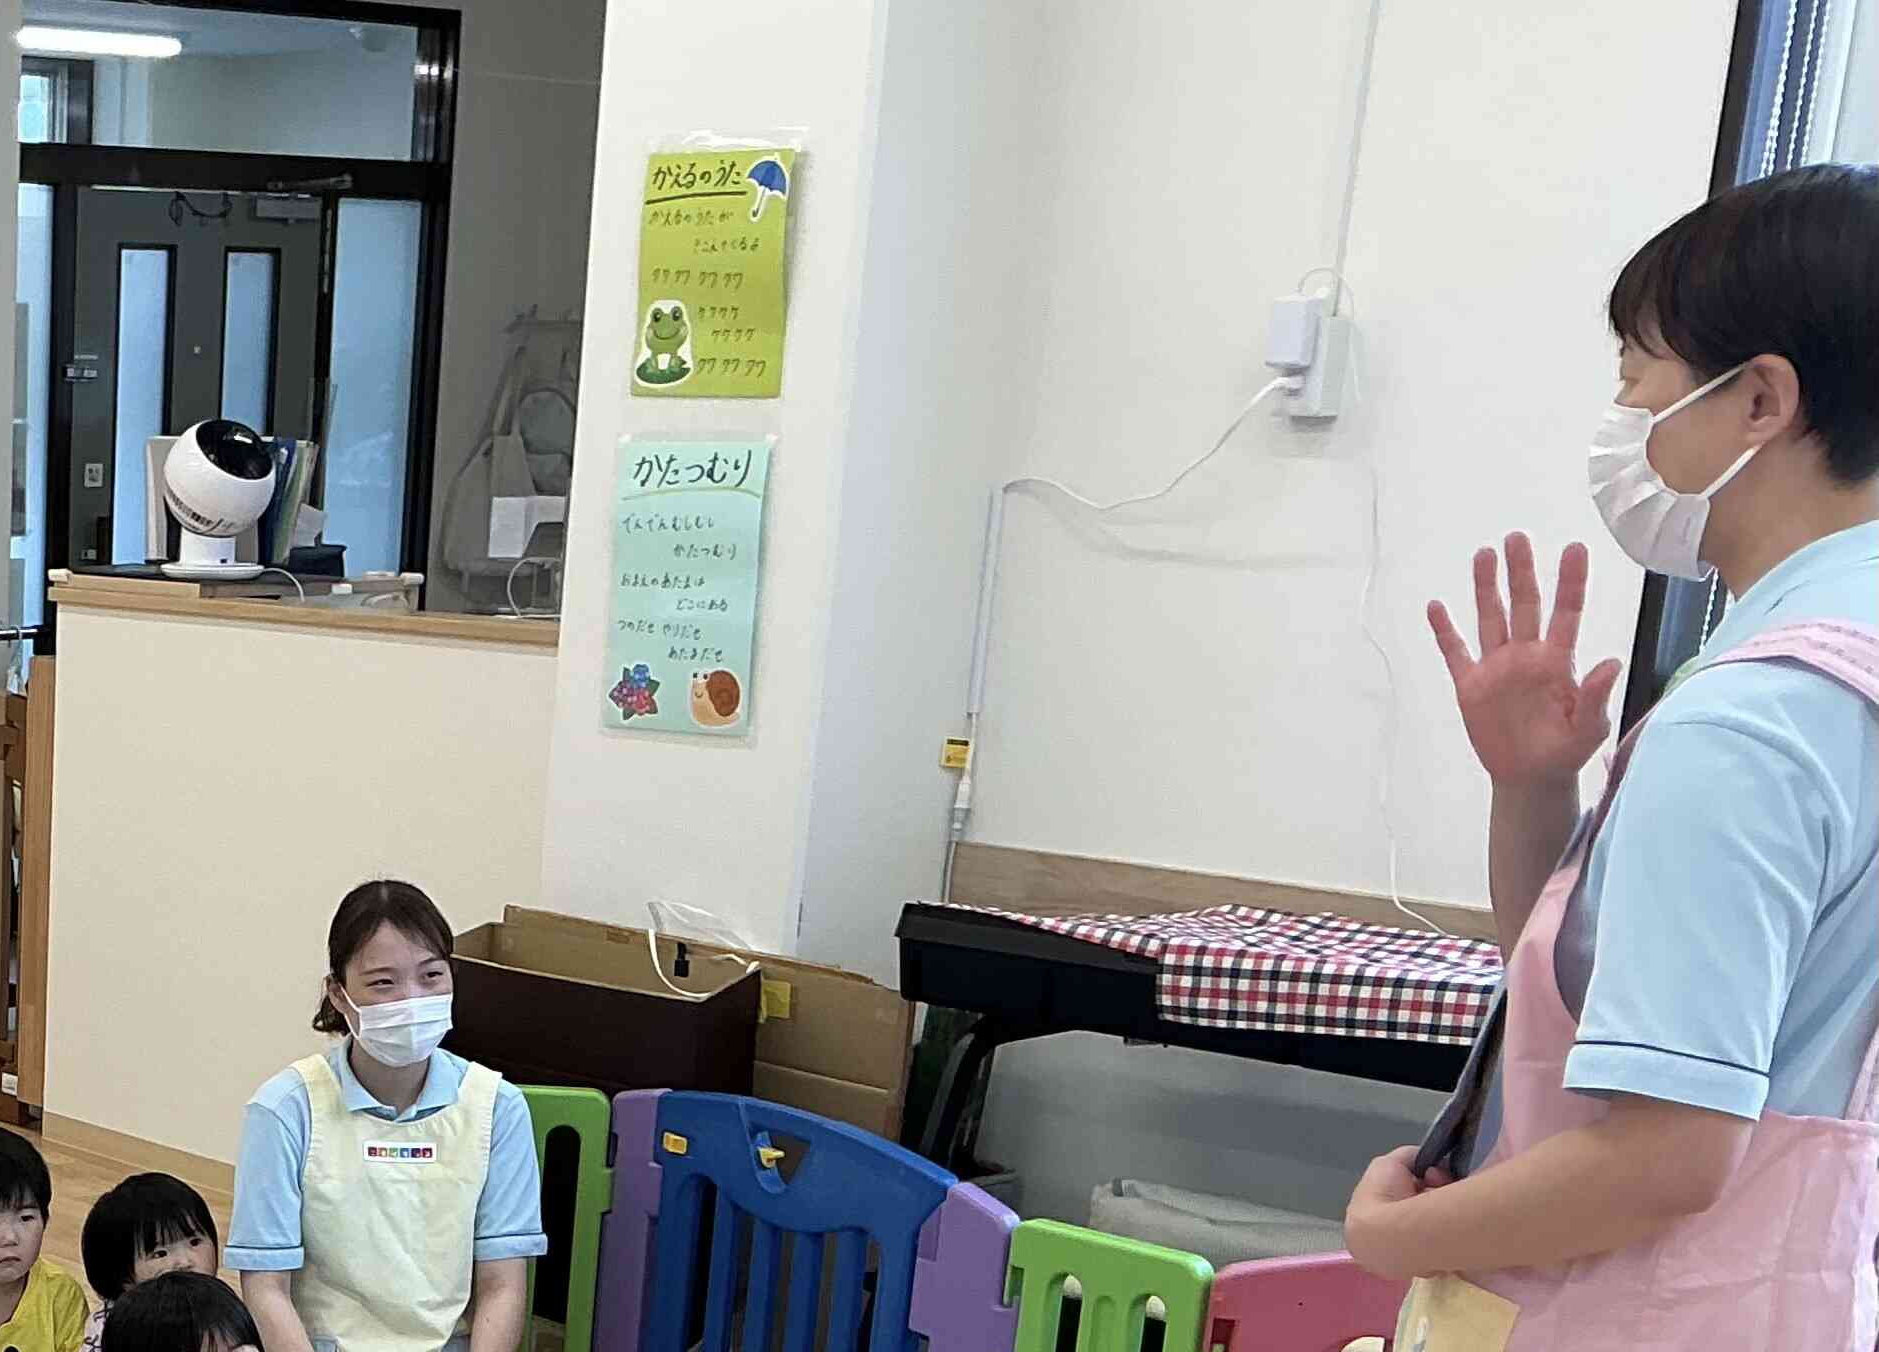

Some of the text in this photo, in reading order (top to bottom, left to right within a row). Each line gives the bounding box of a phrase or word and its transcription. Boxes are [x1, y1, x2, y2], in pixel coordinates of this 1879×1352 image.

[652, 160, 741, 190] かえるのうた
[633, 449, 753, 488] かたつむり
[621, 511, 715, 534] でんでんむしむし
[674, 544, 738, 561] かたつむり
